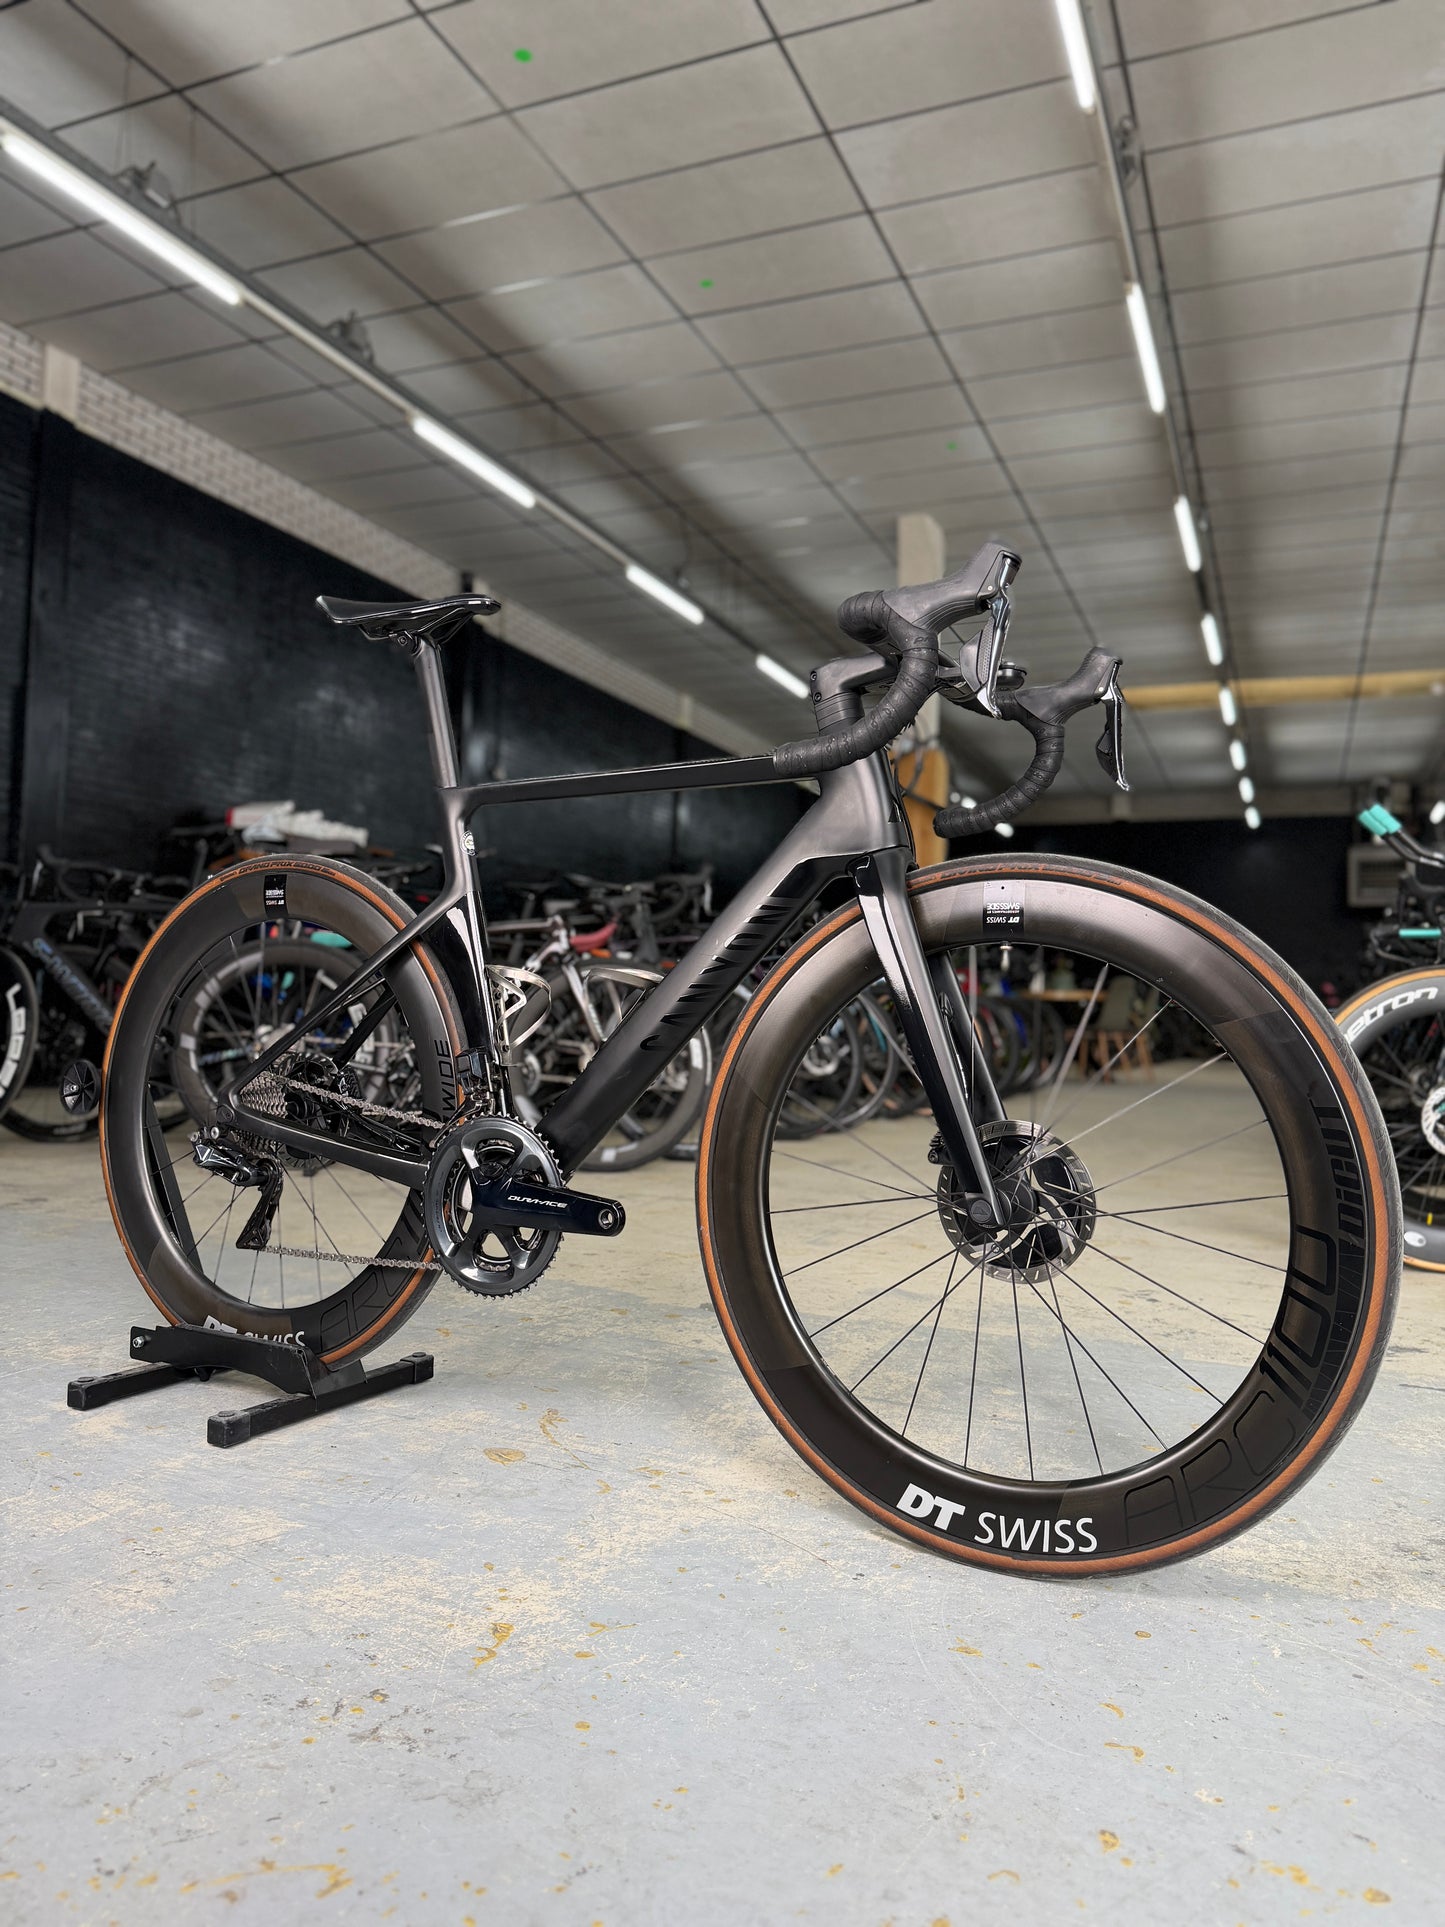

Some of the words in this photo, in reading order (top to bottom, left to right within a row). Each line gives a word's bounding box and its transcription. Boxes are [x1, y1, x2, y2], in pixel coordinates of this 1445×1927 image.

[986, 916, 1007, 924] SWISS
[639, 904, 794, 1051] CANYON
[1344, 986, 1439, 1045] etron
[434, 1039, 457, 1112] WIDE
[507, 1195, 568, 1209] DURA-ACE
[1259, 1223, 1337, 1409] 1100
[1124, 1390, 1297, 1547] ARC
[896, 1483, 966, 1531] DT
[974, 1511, 1099, 1555] SWISS
